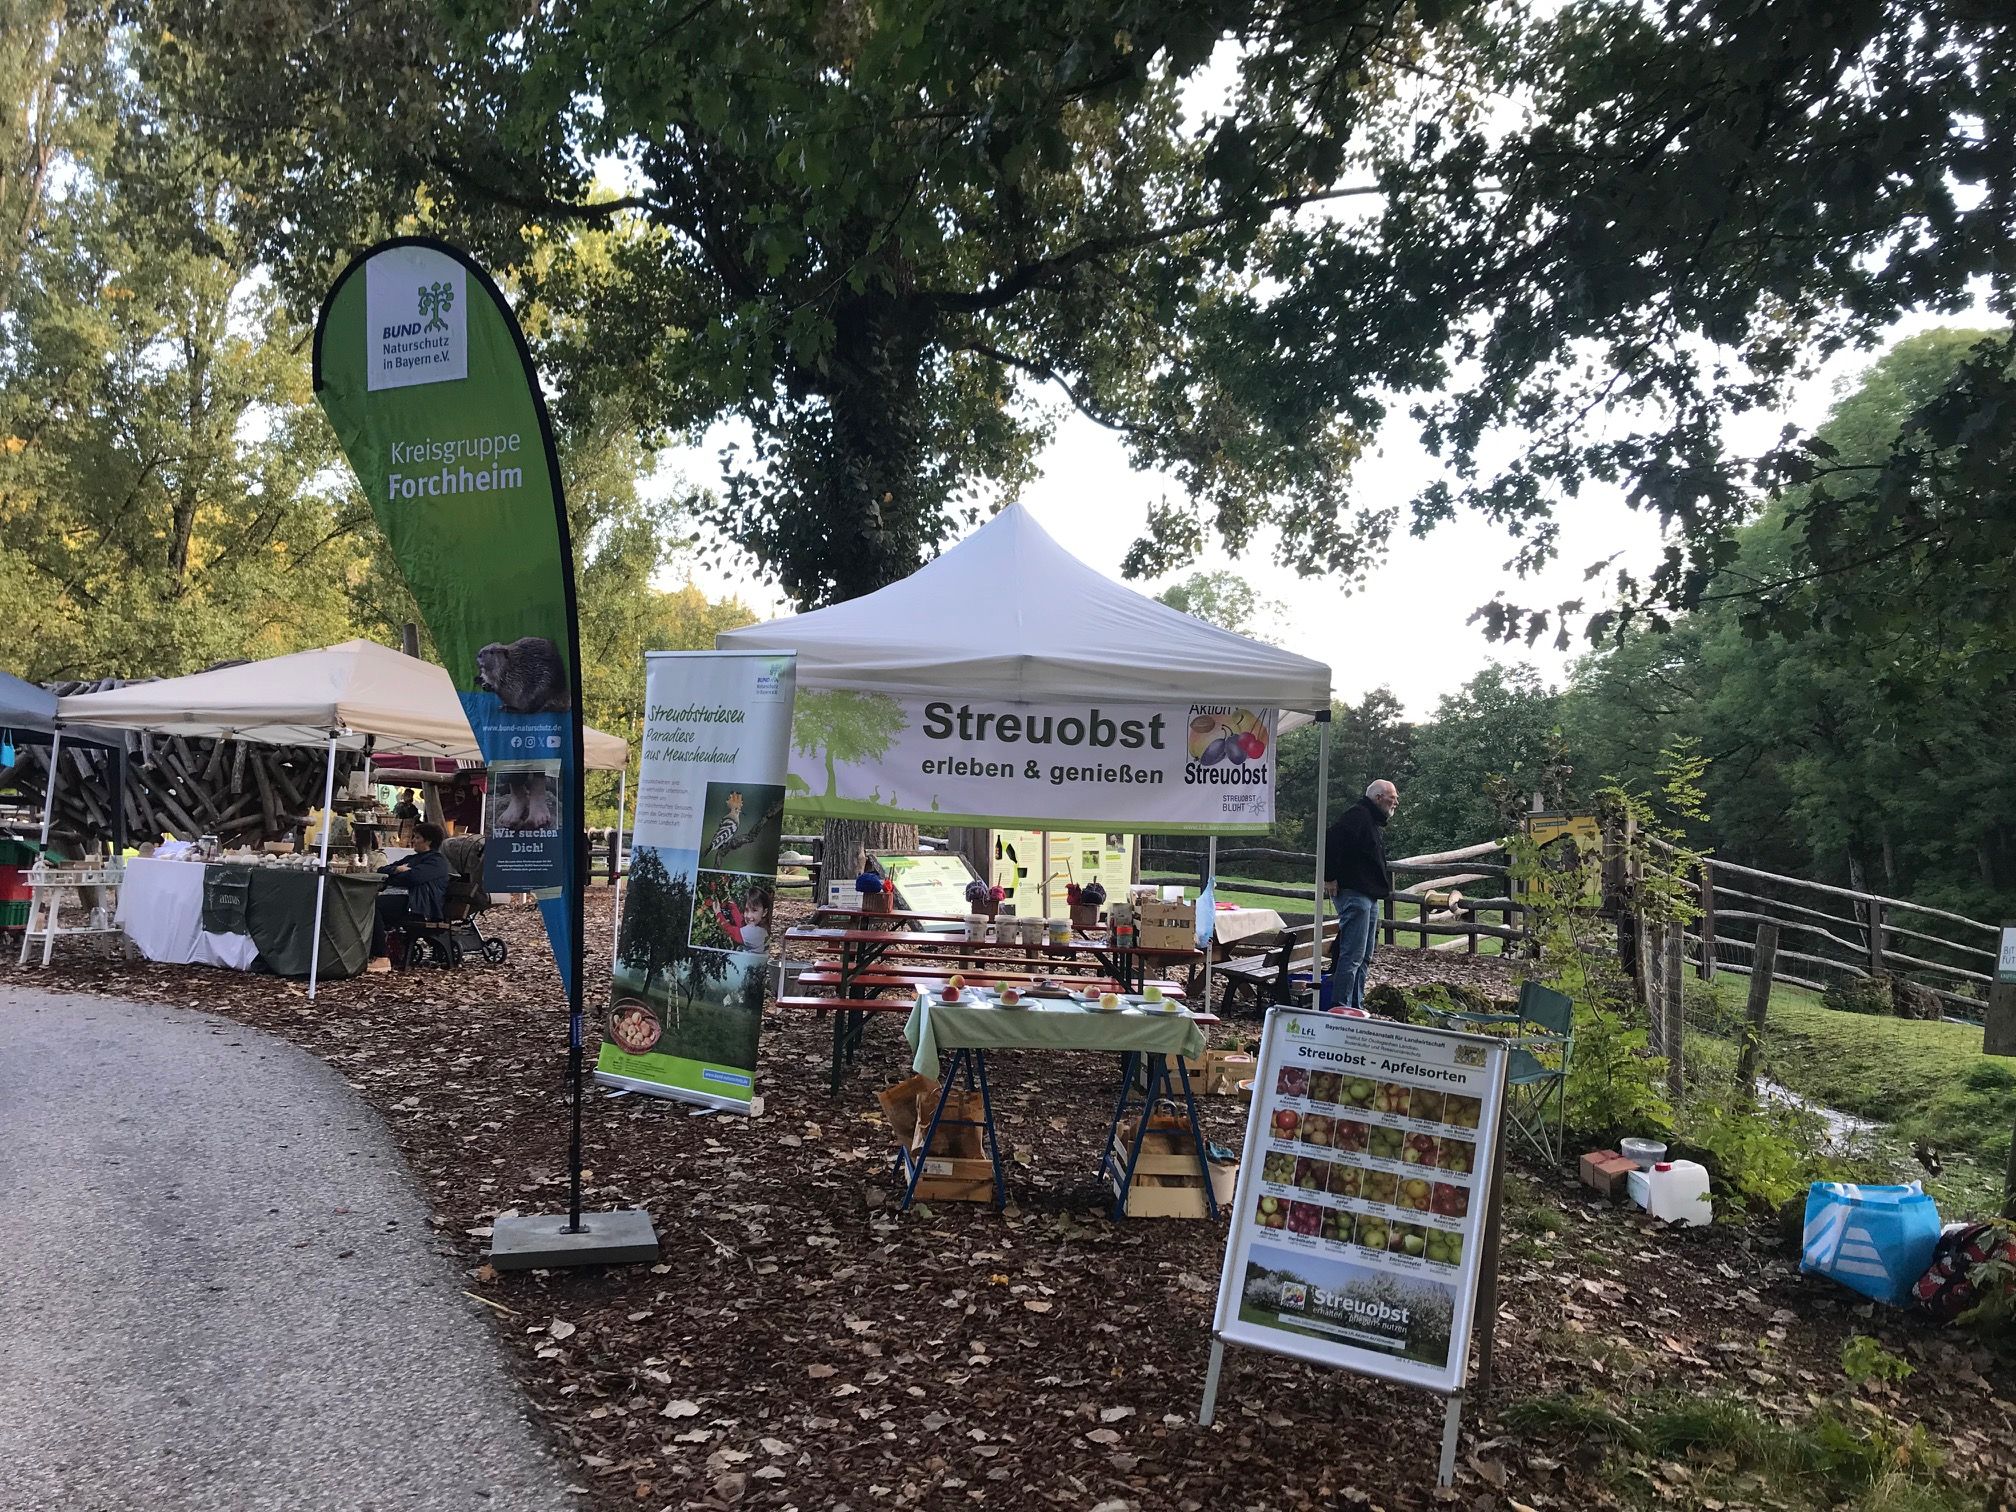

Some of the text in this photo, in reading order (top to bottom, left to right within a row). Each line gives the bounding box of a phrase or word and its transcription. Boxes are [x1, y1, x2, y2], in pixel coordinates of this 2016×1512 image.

[382, 322, 422, 340] BUND
[383, 336, 450, 354] Naturschutz
[384, 350, 450, 370] in Bayern e.V.
[391, 433, 520, 464] Kreisgruppe
[389, 462, 522, 500] Forchheim
[649, 703, 746, 723] Streuobstwiesen
[646, 727, 695, 744] Paradiese
[922, 702, 1166, 750] Streuobst
[644, 746, 738, 764] aus Menschenhand
[922, 756, 1164, 784] erleben & genießen
[1184, 762, 1267, 784] Streuobst
[1222, 794, 1256, 802] STREUOBST
[494, 828, 558, 838] Wir suchen
[512, 843, 543, 853] Dich!
[1302, 1028, 1316, 1036] LfL
[1298, 1046, 1366, 1066] Streuobst
[1380, 1059, 1467, 1083] Apfelsorten
[1313, 1288, 1410, 1324] Streuobst
[1313, 1307, 1343, 1318] erhalten
[1382, 1322, 1407, 1333] nutzen
